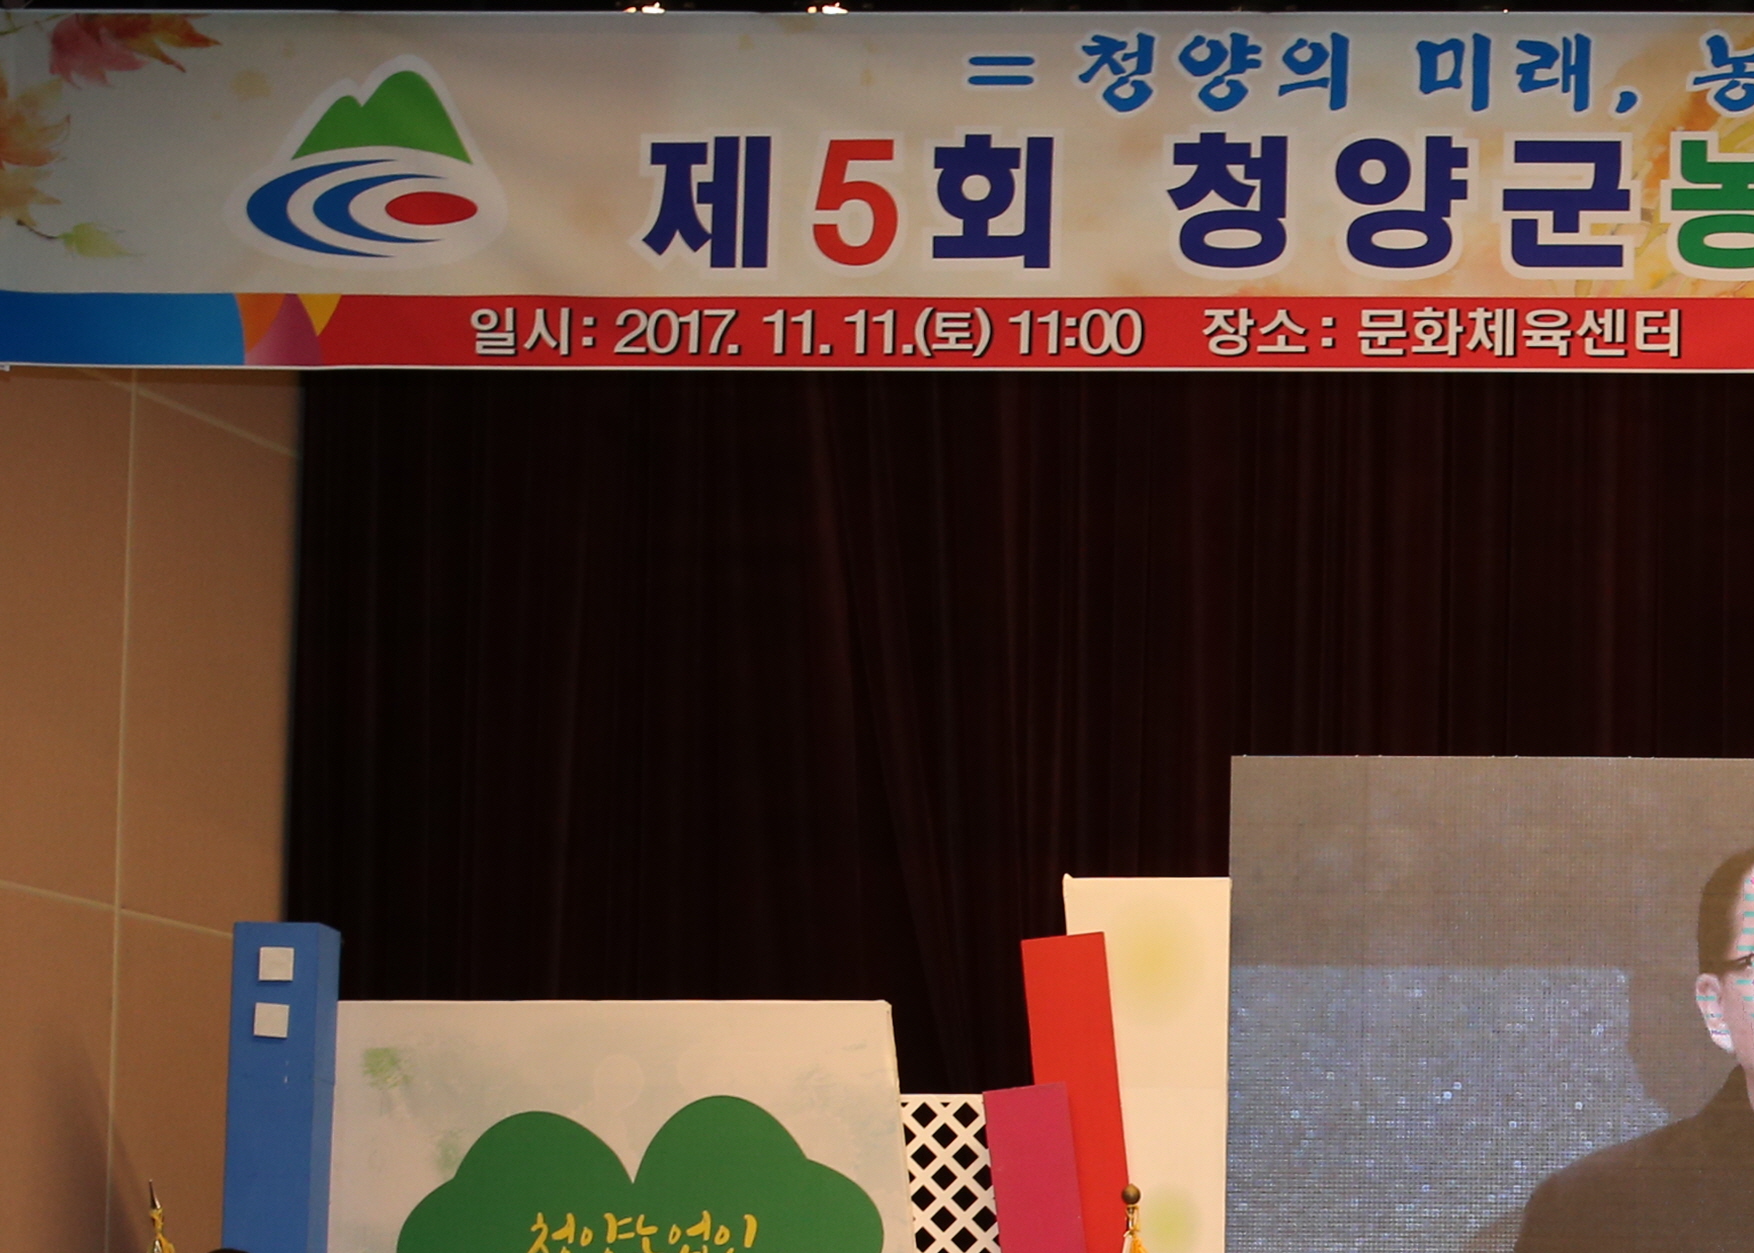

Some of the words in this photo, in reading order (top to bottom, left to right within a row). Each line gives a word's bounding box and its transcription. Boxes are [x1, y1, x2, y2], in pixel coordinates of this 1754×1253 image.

[1079, 32, 1349, 112] 청양의
[1416, 33, 1637, 113] 미래,
[643, 136, 1052, 267] 제5회
[1009, 309, 1143, 355] 11:00
[1357, 306, 1681, 358] 문화체육센터
